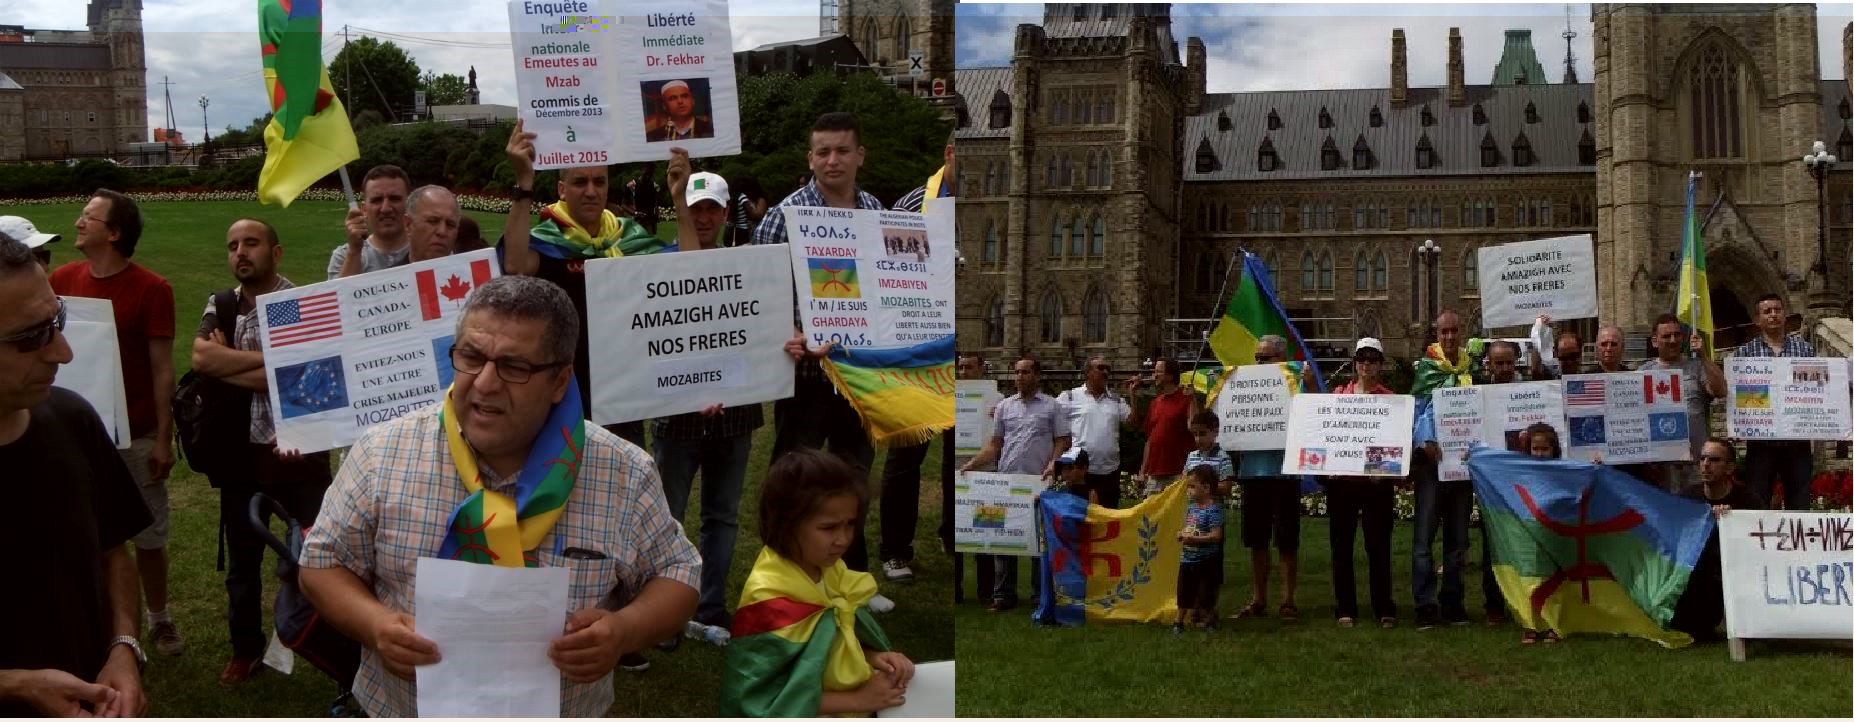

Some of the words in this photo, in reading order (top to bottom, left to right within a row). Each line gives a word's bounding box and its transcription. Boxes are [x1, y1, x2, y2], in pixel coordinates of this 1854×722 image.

[647, 13, 695, 28] Libérté
[643, 34, 704, 48] Immédiate
[531, 42, 590, 56] nationale
[524, 57, 579, 69] Emeutes
[583, 58, 597, 67] au
[646, 55, 664, 67] Dr.
[667, 54, 705, 66] Fekhar
[546, 76, 581, 88] Mzab
[531, 96, 580, 108] commis
[583, 94, 598, 106] de
[535, 107, 580, 118] Décembre
[582, 107, 603, 117] 2013
[566, 126, 576, 142] à
[538, 152, 577, 166] Juillet
[578, 150, 608, 163] 2015
[828, 210, 847, 218] NEKK
[1508, 251, 1562, 265] SOLIDARITE
[1501, 267, 1546, 281] AMAZIGH
[1548, 264, 1572, 275] AVEC
[353, 283, 409, 299] ONU-USA-
[646, 273, 743, 299] SOLIDARITE
[878, 278, 928, 290] IMZABIYEN
[1509, 283, 1529, 294] NOS
[1533, 280, 1564, 292] FRERES
[838, 301, 847, 311] JE
[848, 301, 868, 311] SUIS
[880, 296, 932, 308] MOZABITES
[358, 303, 411, 319] CANADA-
[631, 305, 713, 330] AMAZIGH
[718, 300, 760, 320] AVEC
[363, 321, 412, 338] EUROPE
[812, 317, 868, 328] GHARDAYA
[938, 322, 951, 330] BIEN
[648, 337, 684, 357] NOS
[689, 329, 747, 351] FRERES
[913, 333, 928, 341] LEUR
[355, 349, 426, 373] EVITEZ-NOUS
[362, 376, 383, 389] UNE
[386, 368, 422, 384] AUTRE
[657, 370, 722, 388] MOZABITES
[353, 395, 385, 410] CRISE
[387, 384, 438, 401] MAJEURE
